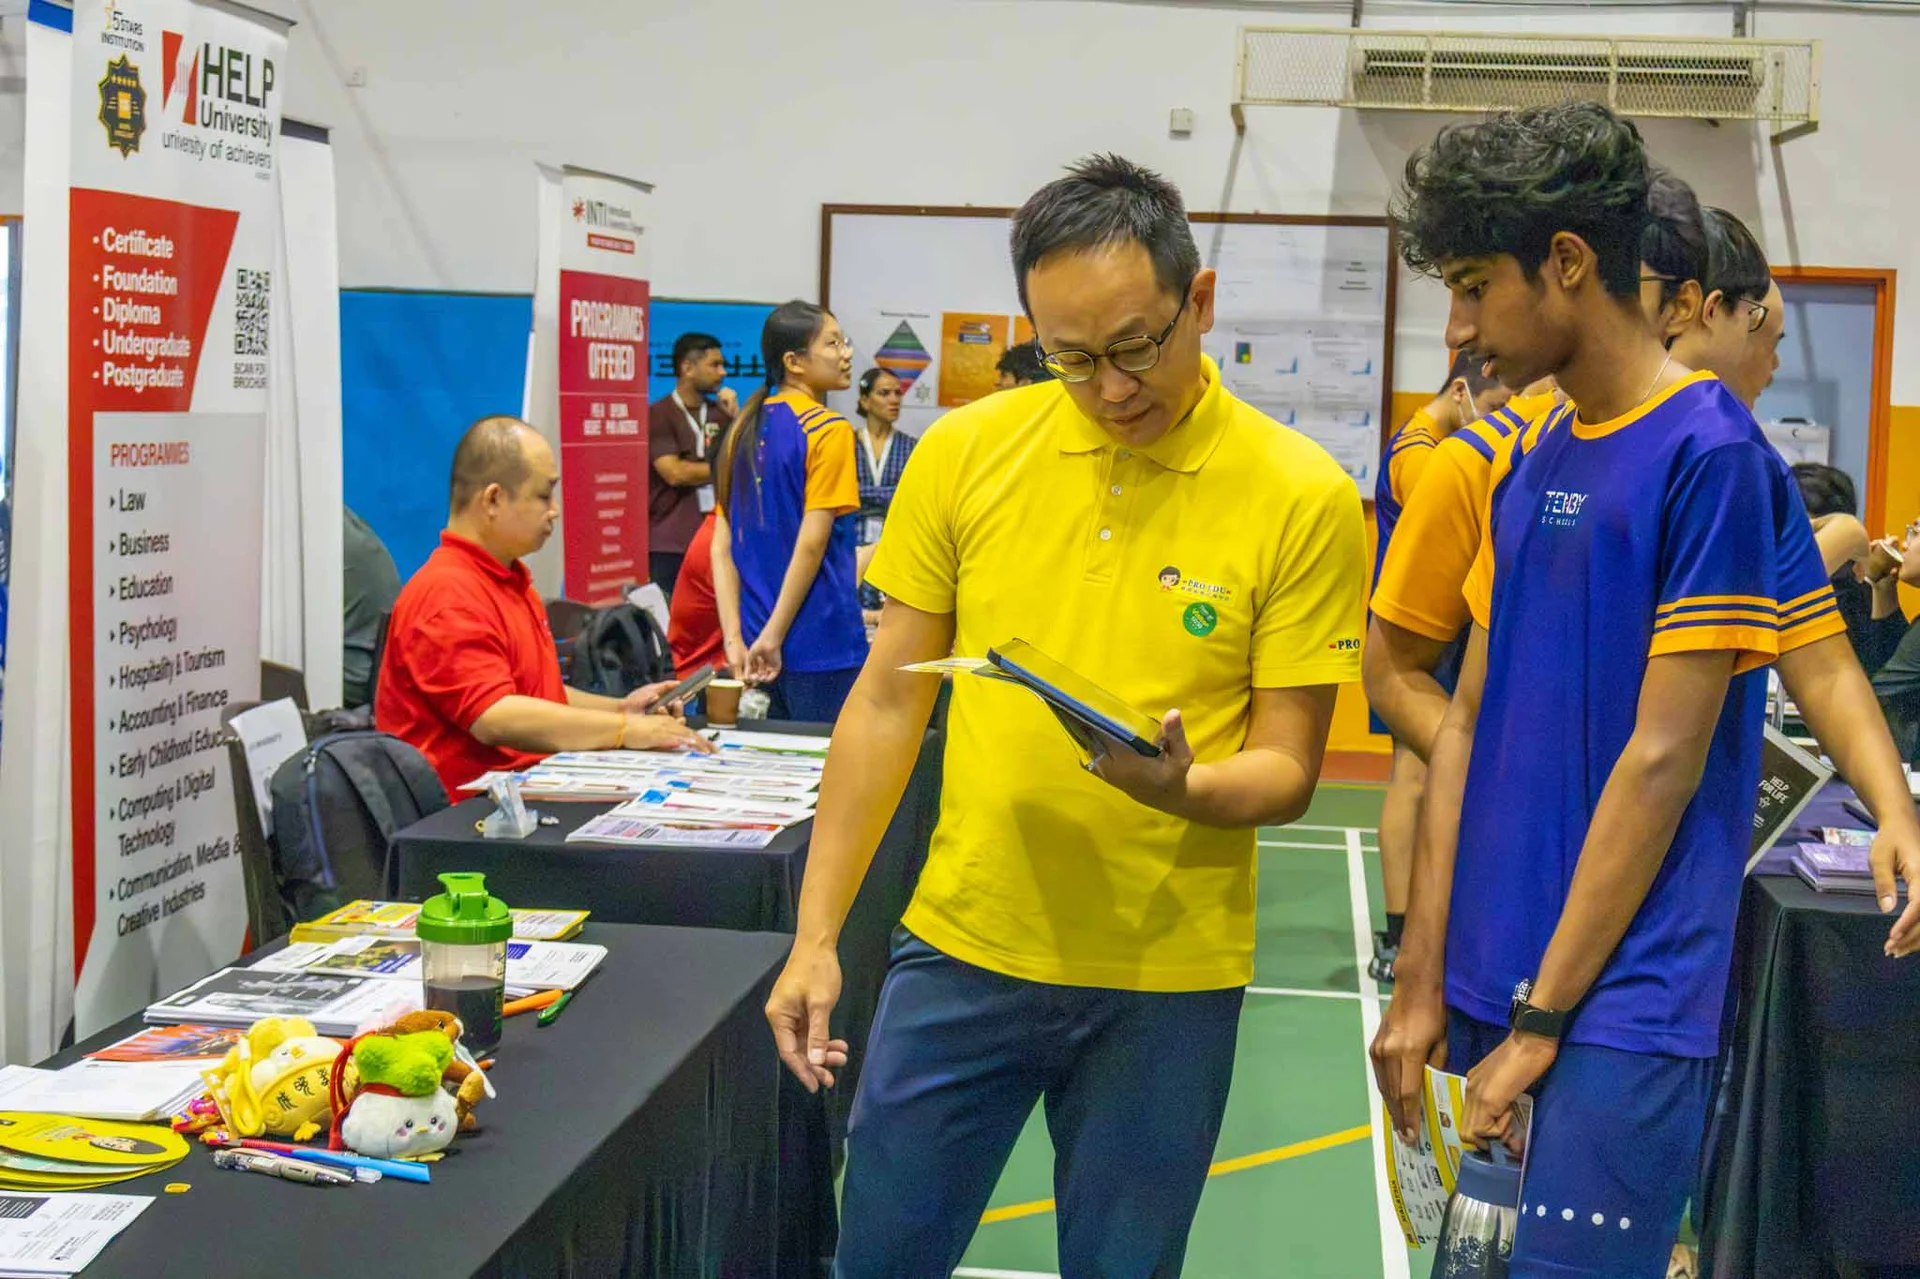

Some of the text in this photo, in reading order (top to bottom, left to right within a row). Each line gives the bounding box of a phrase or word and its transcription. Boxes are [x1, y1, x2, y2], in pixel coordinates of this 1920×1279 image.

[101, 32, 145, 52] INSTITUTION
[203, 42, 275, 109] HELP
[201, 101, 273, 147] University
[163, 130, 207, 161] university
[211, 139, 223, 159] of
[586, 198, 608, 226] INTI
[103, 226, 174, 259] Certificate
[103, 265, 178, 295] Foundation
[103, 297, 161, 328] Diploma
[570, 299, 644, 342] PROGRAMMES
[103, 329, 191, 362] Undergraduate
[588, 342, 635, 380] OFFERED
[103, 361, 184, 393] Postgraduate
[110, 442, 190, 468] PROGRAMMES
[119, 488, 146, 512] Law
[1545, 491, 1589, 514] TENBY
[119, 530, 170, 556] Business
[119, 572, 174, 601] Education
[119, 614, 178, 649] Psychology
[1338, 639, 1360, 650] PRO
[119, 646, 226, 691] Hospitality & Tourism
[119, 689, 229, 734] Accounting & Finance
[119, 752, 145, 778] Early
[149, 736, 193, 769] Childhood
[118, 766, 216, 821] Computing & Digital
[1770, 776, 1789, 791] HELP
[118, 819, 176, 857] Technology
[197, 841, 230, 868] Media
[117, 880, 206, 937] Creative Industries
